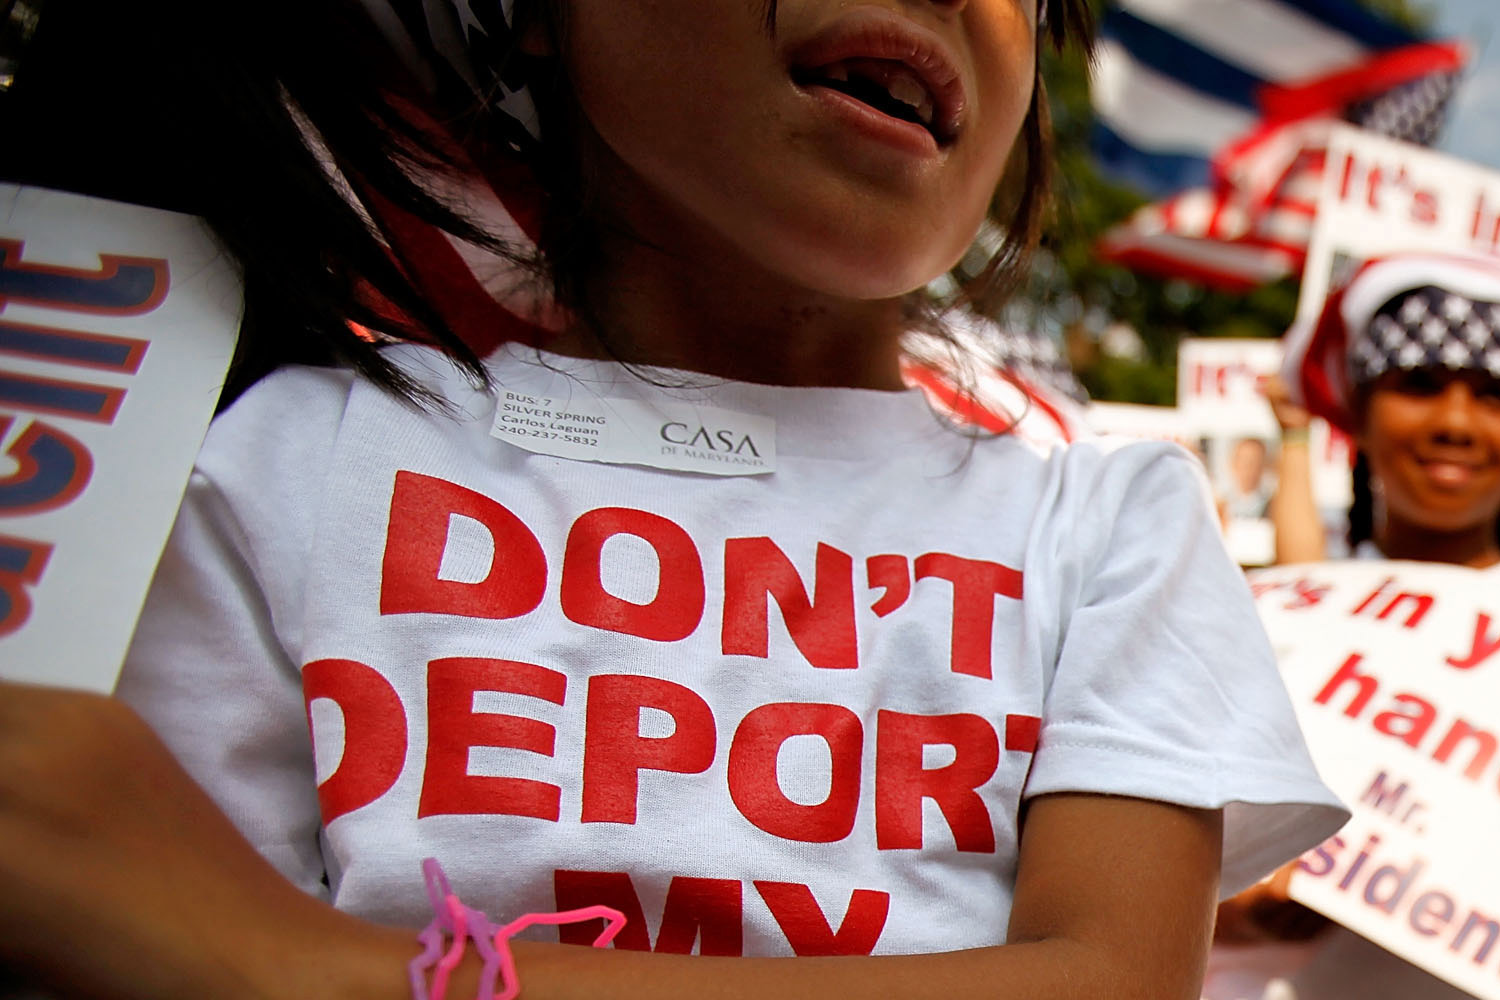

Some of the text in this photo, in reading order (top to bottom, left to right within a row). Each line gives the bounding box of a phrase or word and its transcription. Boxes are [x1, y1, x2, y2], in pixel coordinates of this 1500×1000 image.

[503, 403, 606, 425] SILVER SPRING
[543, 399, 553, 407] 7
[499, 425, 598, 447] 240-237-5832
[501, 415, 599, 436] Carlos Laguan
[660, 422, 760, 458] CASA
[380, 469, 1024, 680] DON'T
[1349, 575, 1437, 629] in
[1359, 769, 1428, 834] Mr.
